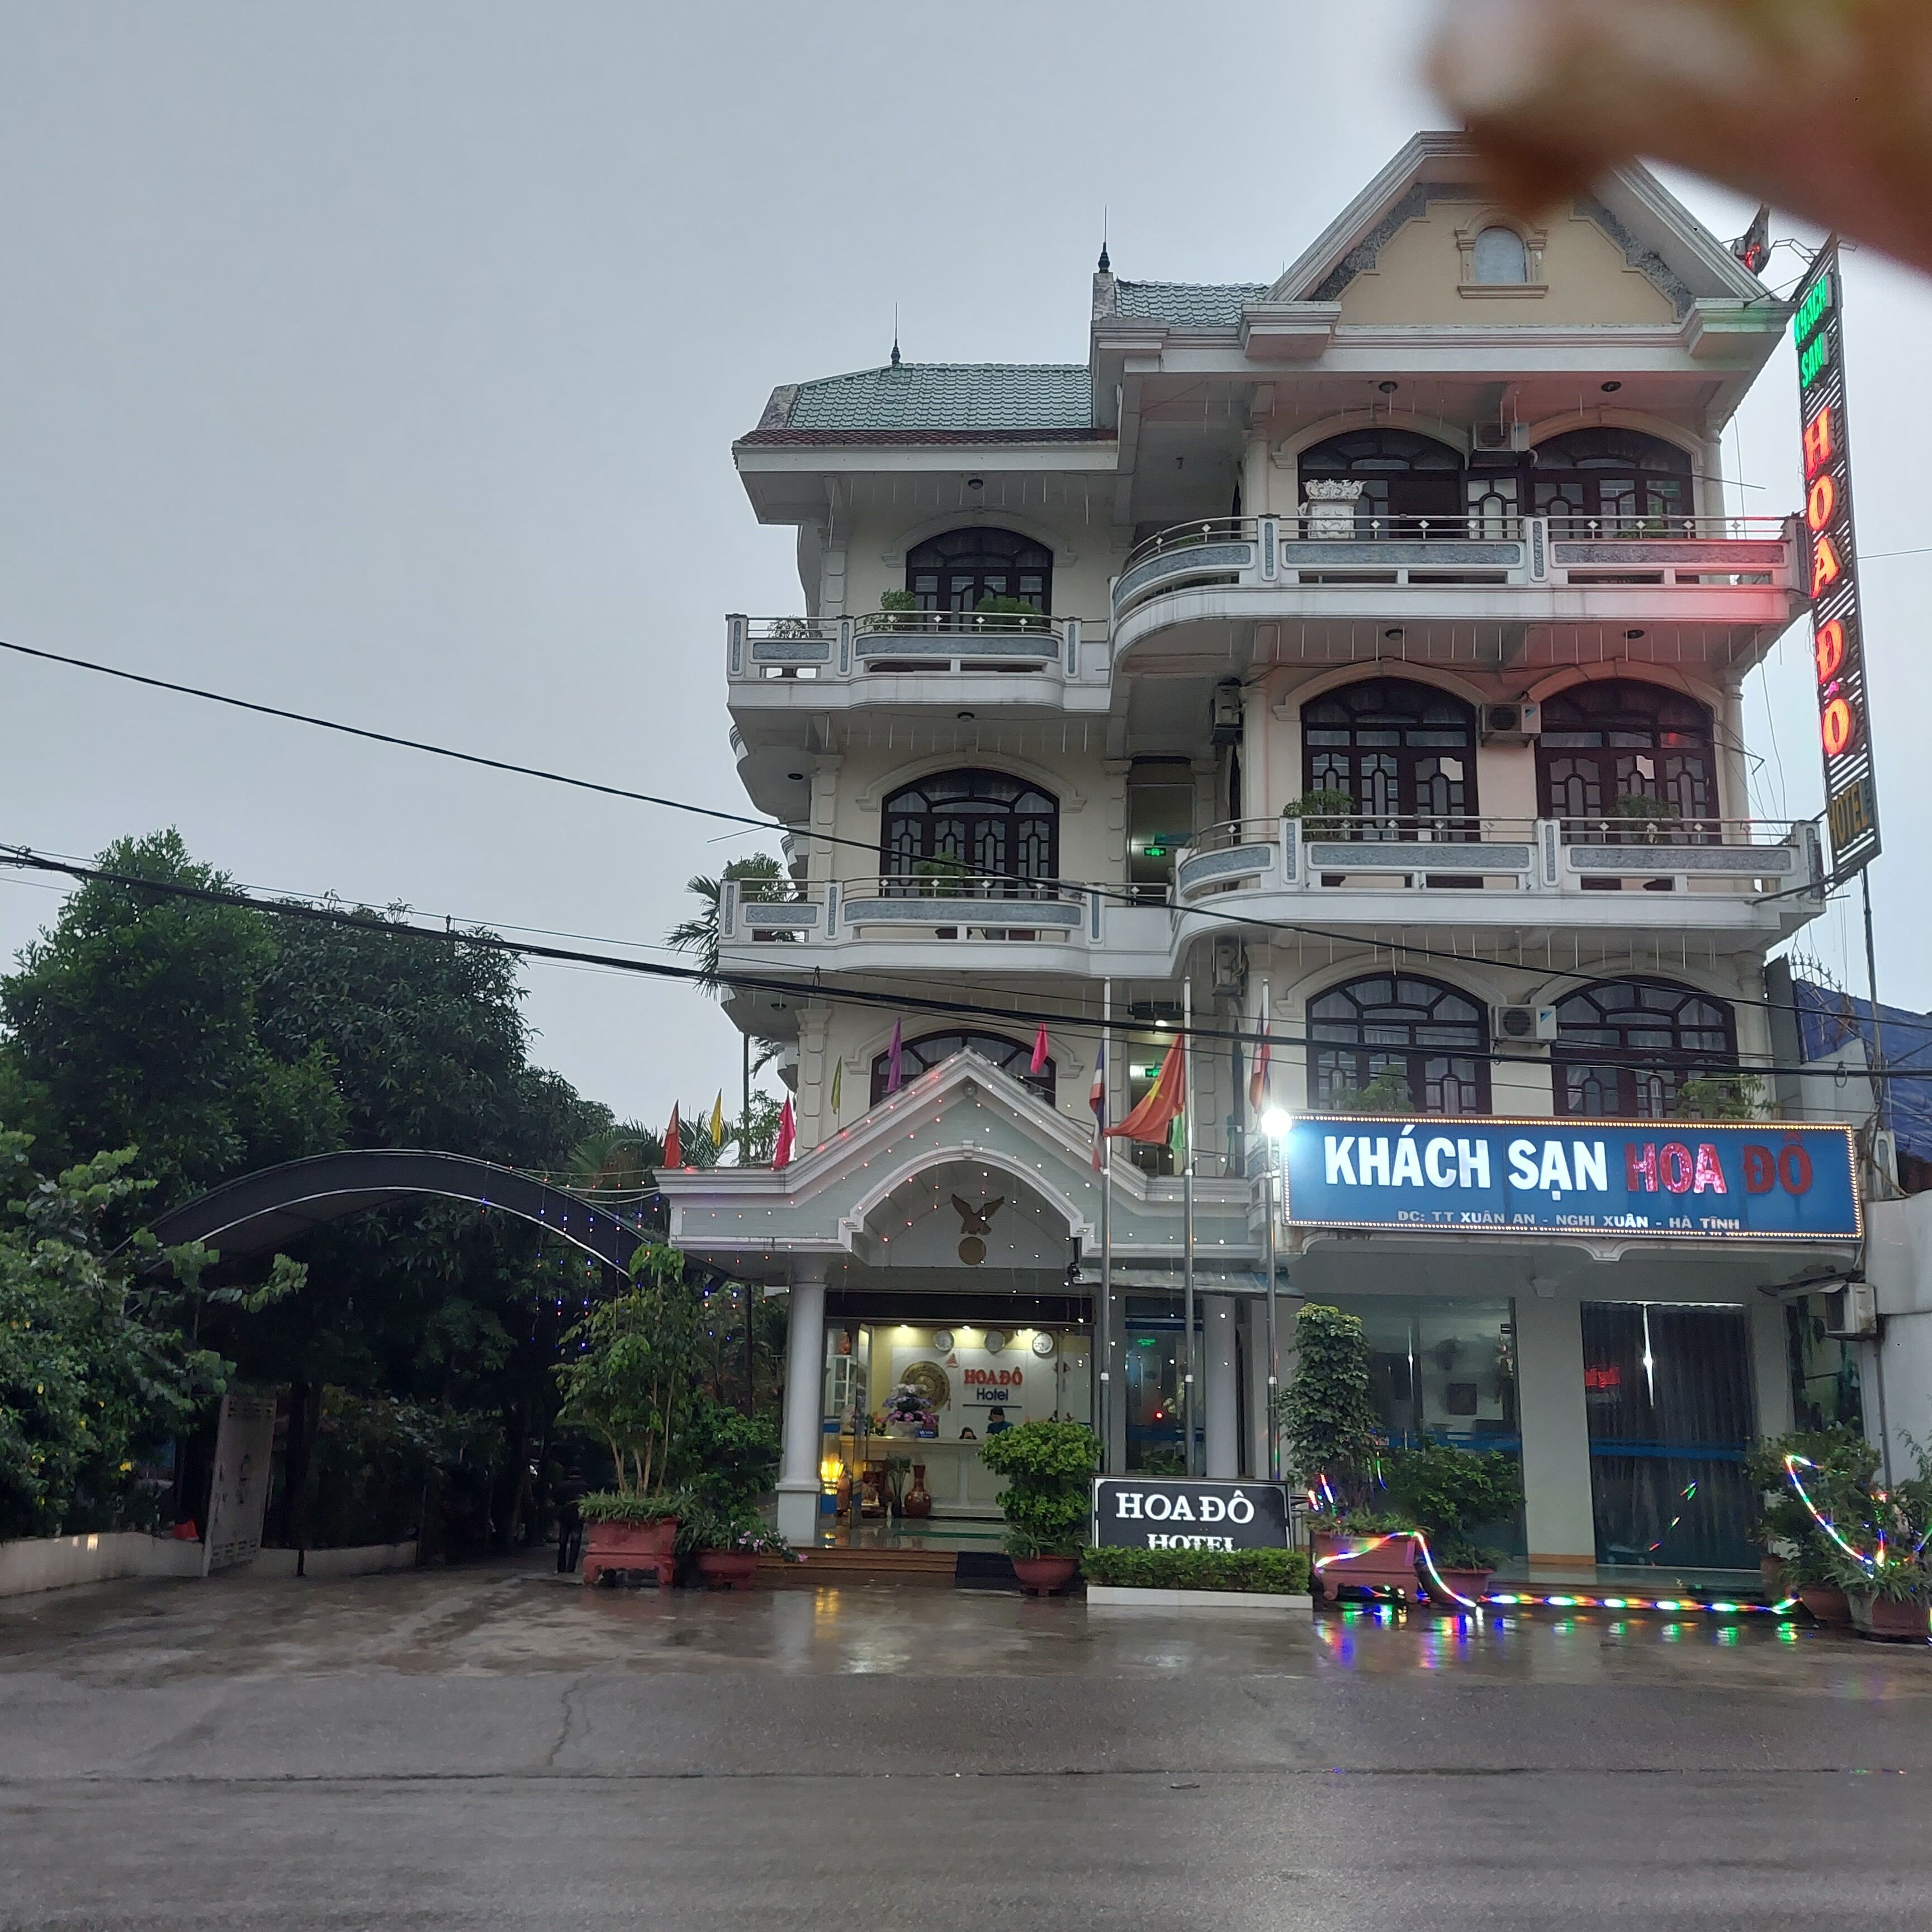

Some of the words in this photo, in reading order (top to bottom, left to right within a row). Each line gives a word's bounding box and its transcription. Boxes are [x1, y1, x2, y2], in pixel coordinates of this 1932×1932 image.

[1324, 1124, 1491, 1188] KHÁCH
[1508, 1139, 1608, 1201] SẠN
[1625, 1142, 1727, 1194] HOA
[1742, 1130, 1813, 1196] ĐÔ
[1431, 1211, 1453, 1223] TT
[1460, 1210, 1505, 1224] XUÂN
[1512, 1213, 1535, 1225] AN
[1556, 1214, 1595, 1227] NGHI
[1602, 1213, 1649, 1228] XUÂN
[1669, 1215, 1693, 1229] HÀ
[1699, 1216, 1740, 1230] TĨNH
[977, 1387, 1008, 1401] Hotel
[1147, 1533, 1242, 1554] HOTEL
